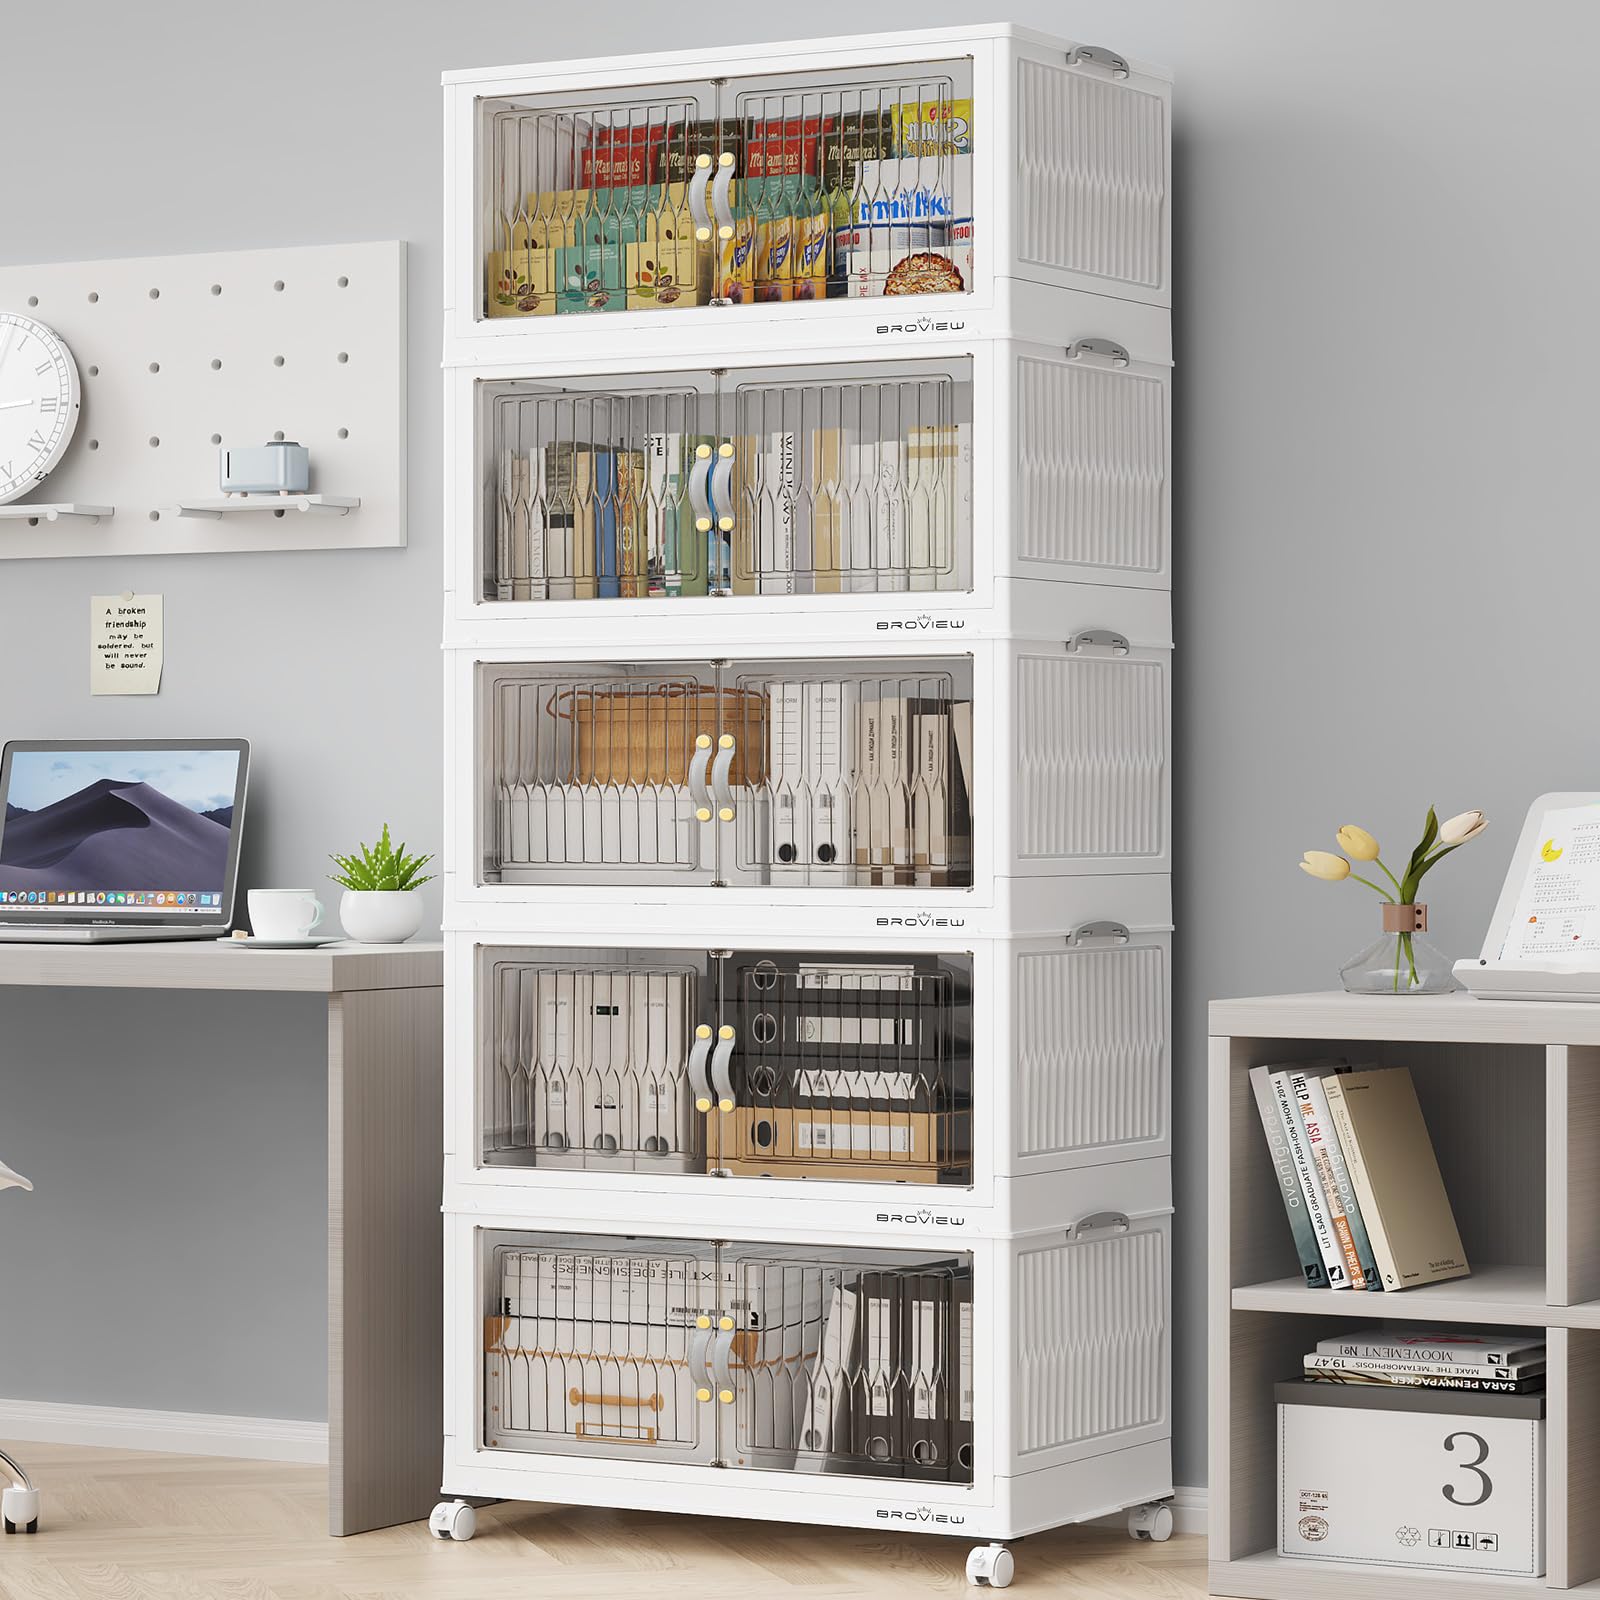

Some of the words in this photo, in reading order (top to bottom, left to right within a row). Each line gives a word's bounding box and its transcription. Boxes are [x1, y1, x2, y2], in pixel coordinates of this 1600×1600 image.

[876, 322, 964, 334] BROVIEW
[40, 398, 57, 412] III
[27, 430, 46, 452] IV
[105, 620, 146, 629] friendship
[876, 620, 964, 629] BROVIEW
[876, 918, 964, 926] BROVIEW
[1275, 1080, 1286, 1098] 2014
[1281, 1100, 1294, 1125] SHOW
[1292, 1076, 1309, 1100] HELP
[1306, 1122, 1322, 1144] ASIA
[1264, 1106, 1300, 1208] avantgarde
[1301, 1167, 1320, 1210] GRADUATE
[876, 1214, 964, 1225] BROVIEW
[1315, 1214, 1327, 1235] LSAD
[1321, 1236, 1332, 1249] LIT
[1346, 1251, 1360, 1276] PHELPS
[1364, 1346, 1453, 1361] MOOVEMENT
[1314, 1358, 1346, 1368] 19,47
[1391, 1376, 1478, 1389] PENNYPACKER
[1482, 1380, 1516, 1391] SARA
[1442, 1431, 1494, 1506] 3
[876, 1510, 964, 1524] BROVIEW
